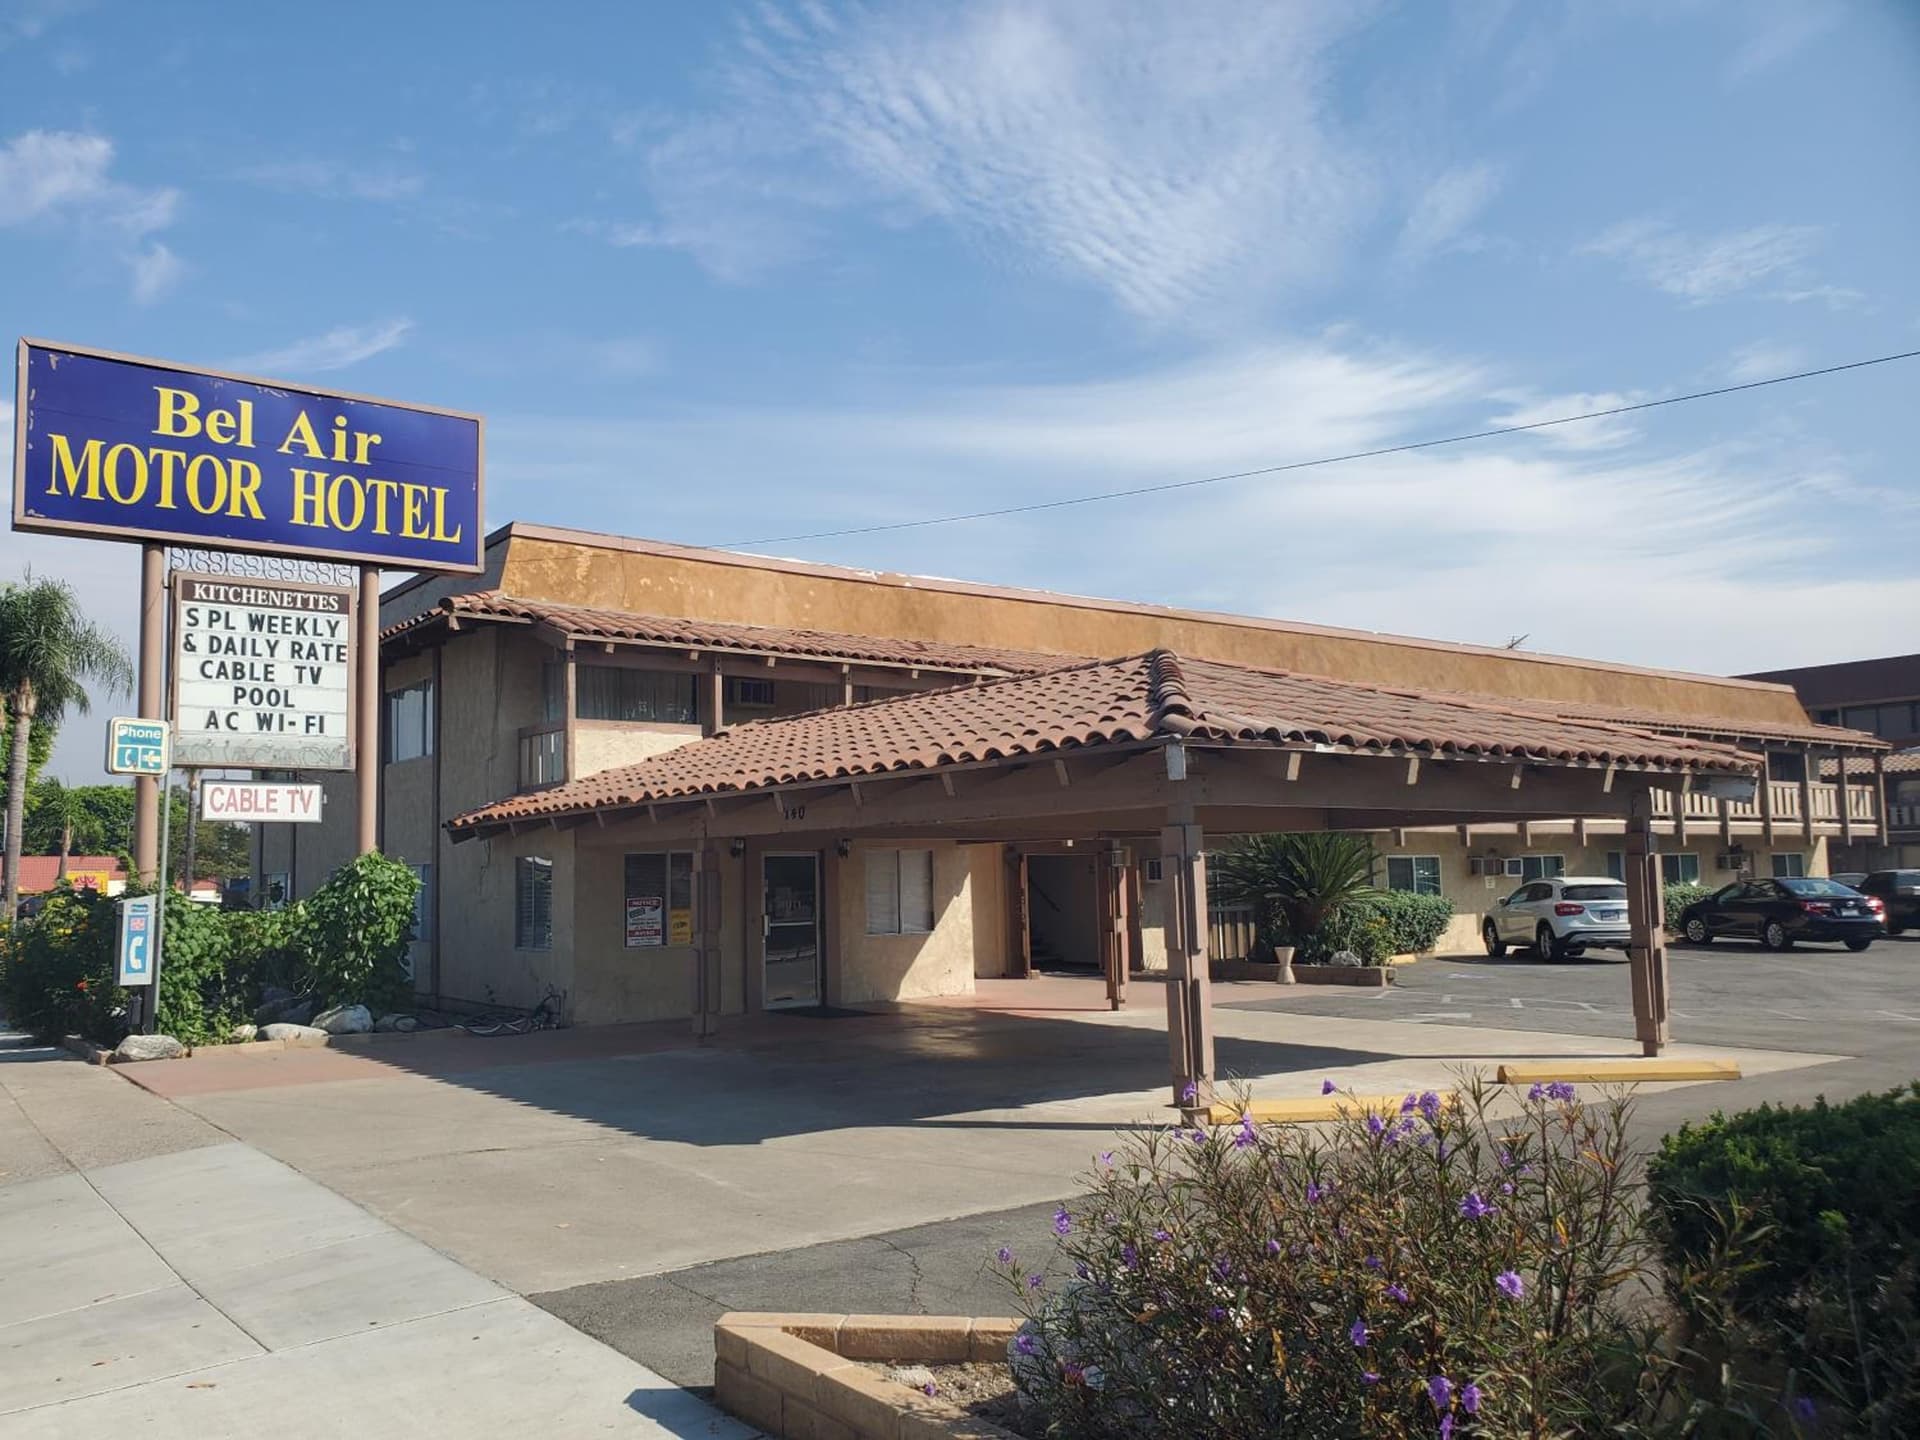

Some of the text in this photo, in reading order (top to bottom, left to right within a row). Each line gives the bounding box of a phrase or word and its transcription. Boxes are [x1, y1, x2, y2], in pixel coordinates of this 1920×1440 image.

[152, 386, 382, 465] Bel Air
[45, 433, 462, 543] MOTOR HOTEL
[193, 582, 339, 611] KITCHENETTES
[248, 613, 340, 638] WEEKLY
[183, 633, 347, 663] & DAILY RATE
[200, 660, 323, 684] CABLE TV
[233, 686, 295, 708] POOL
[118, 725, 162, 740] Phone
[209, 786, 313, 813] CABLE TV
